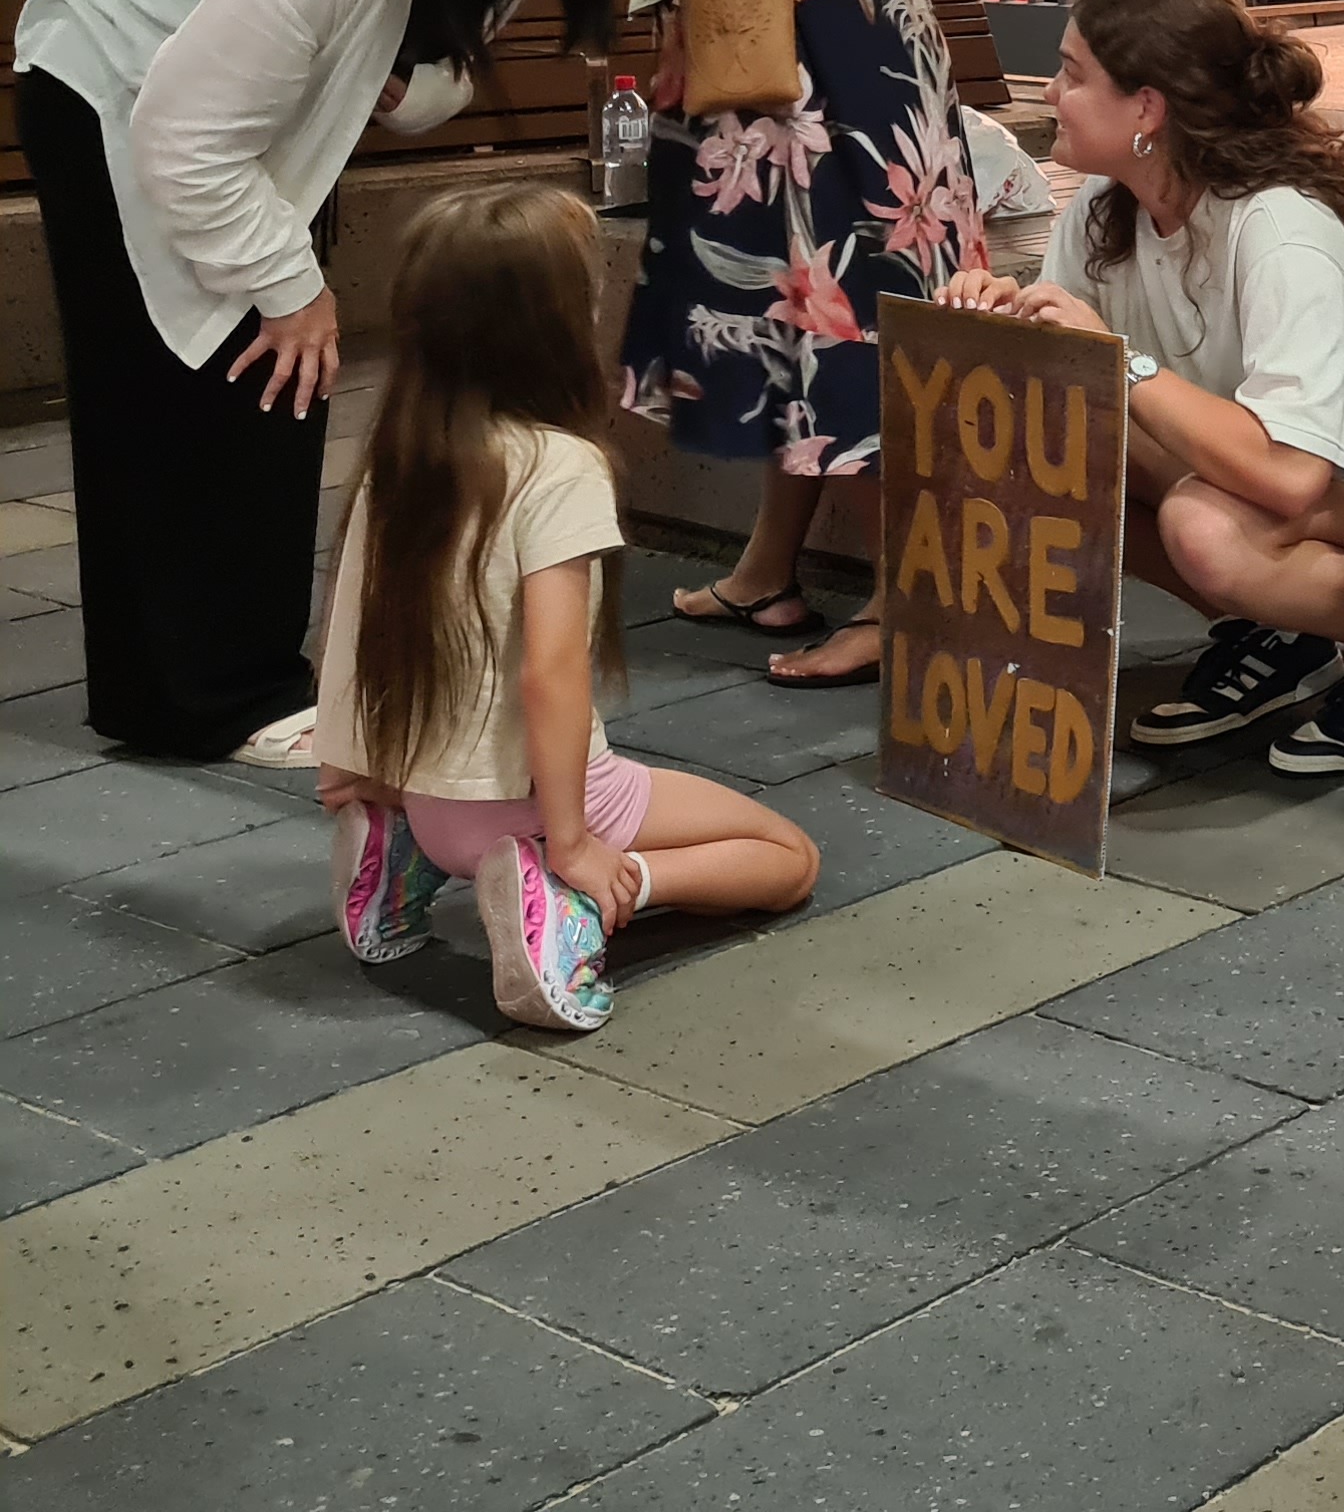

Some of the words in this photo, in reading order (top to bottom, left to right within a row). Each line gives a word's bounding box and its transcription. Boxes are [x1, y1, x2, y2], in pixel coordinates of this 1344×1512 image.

[890, 343, 1088, 502] YOU
[896, 488, 1085, 648] ARE
[890, 630, 1094, 805] LOVED
